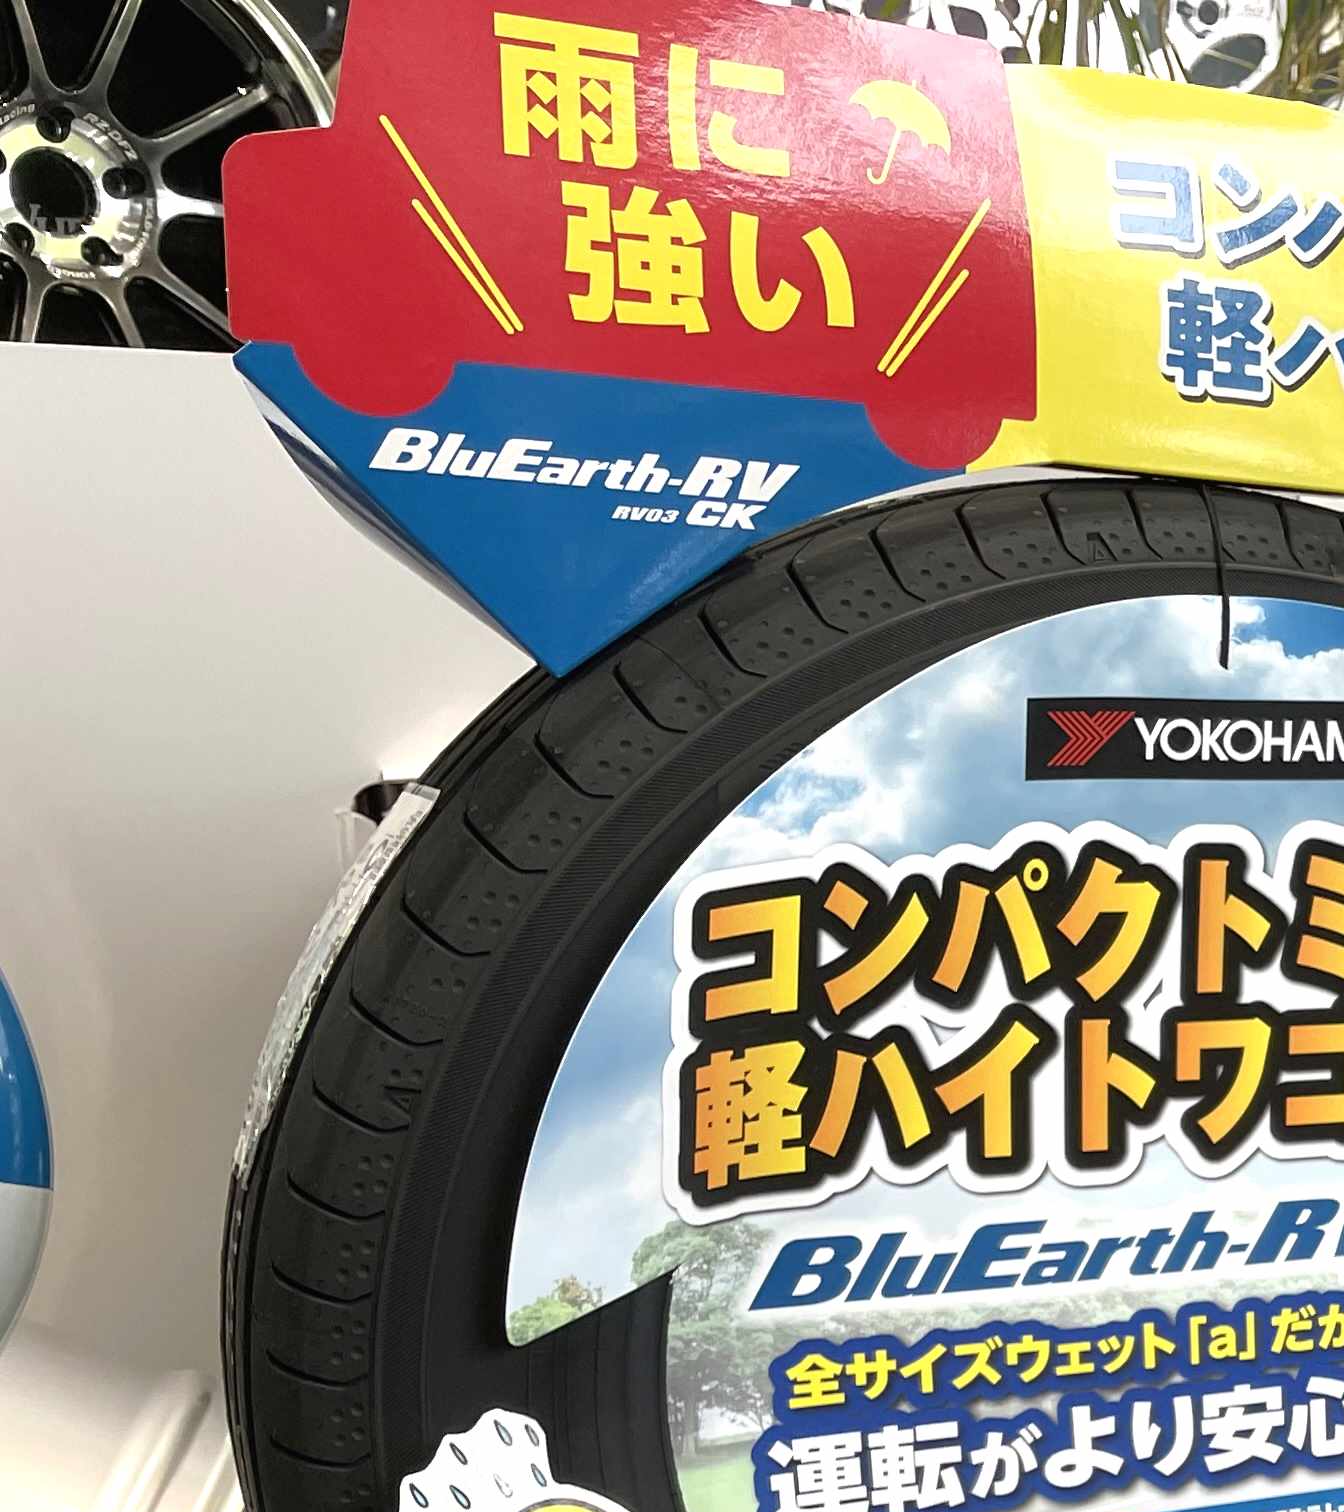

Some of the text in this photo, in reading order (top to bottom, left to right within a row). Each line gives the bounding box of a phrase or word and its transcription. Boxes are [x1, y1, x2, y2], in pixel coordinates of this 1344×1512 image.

[494, 11, 791, 176] 雨に
[561, 180, 854, 334] 強い
[369, 429, 800, 503] BluEarth-RV
[612, 501, 766, 531] RV03 CK
